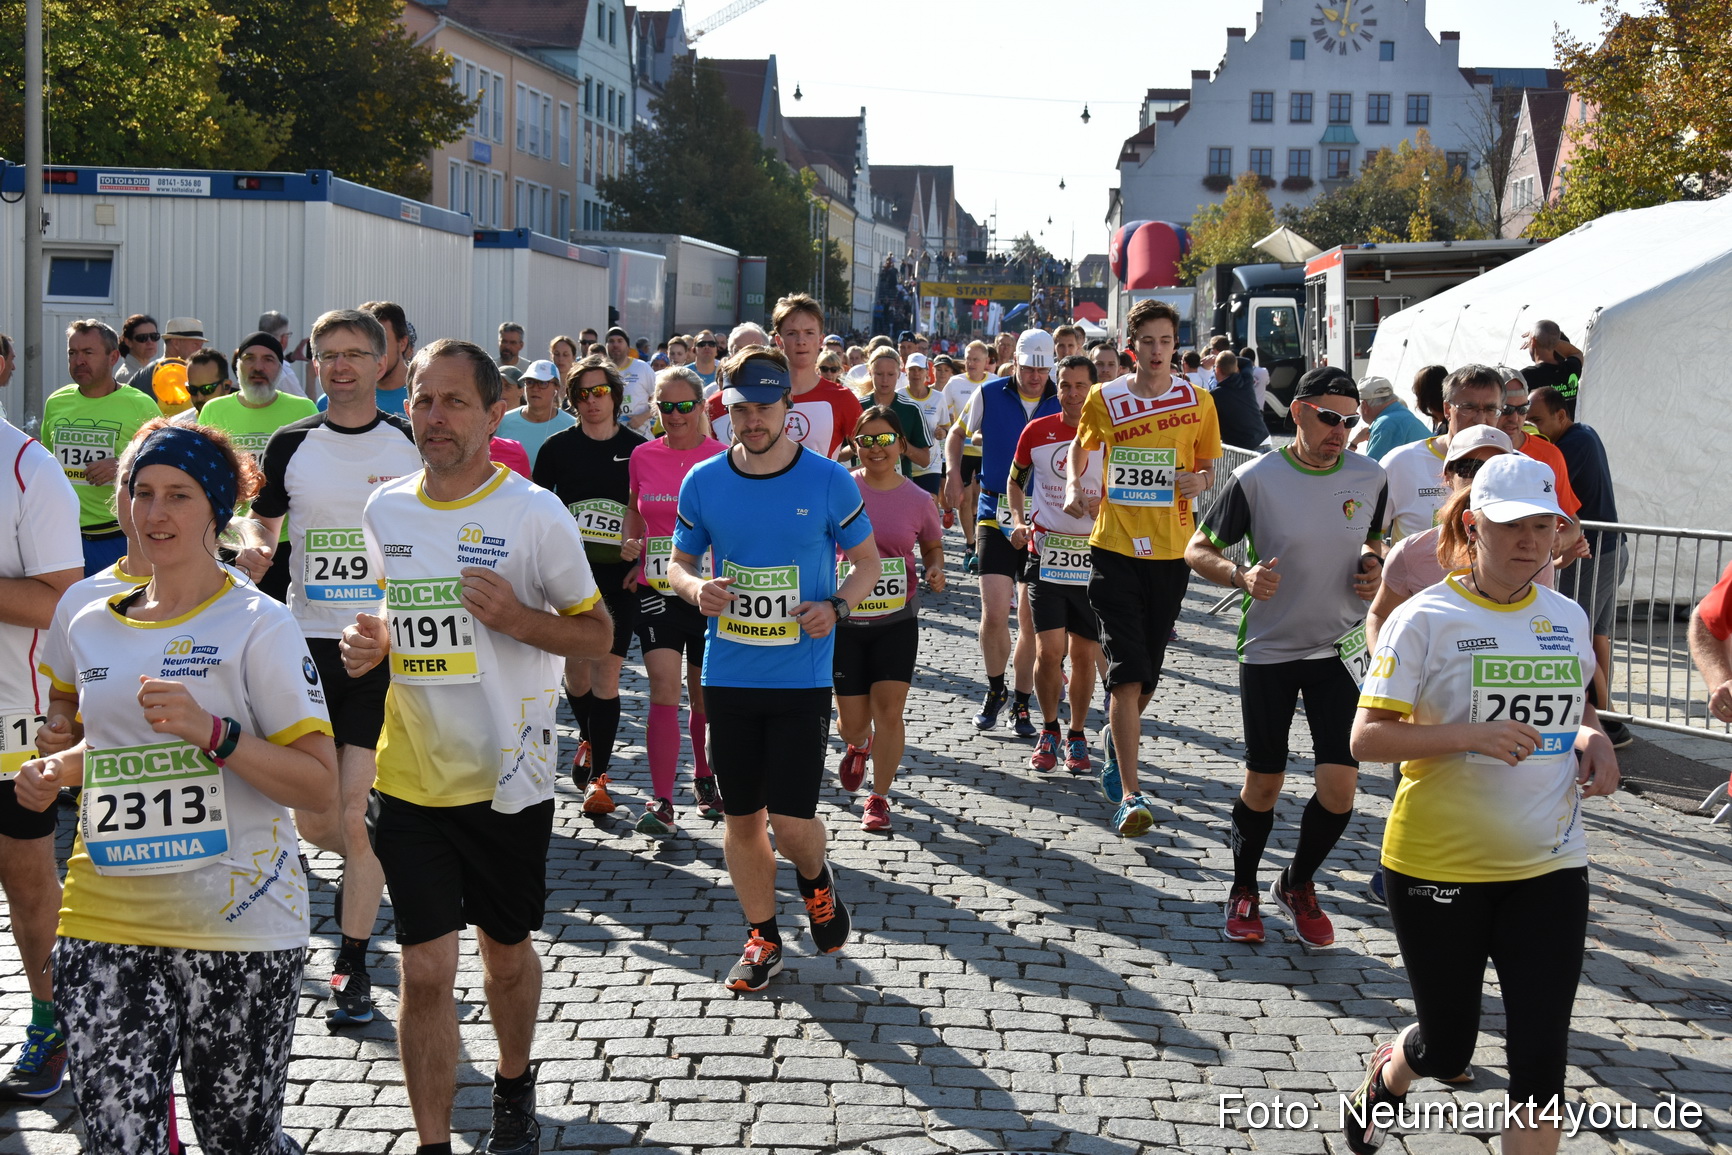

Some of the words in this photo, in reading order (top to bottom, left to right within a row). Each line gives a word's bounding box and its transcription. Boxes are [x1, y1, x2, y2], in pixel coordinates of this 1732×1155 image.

[133, 178, 149, 186] DIXI
[955, 286, 994, 296] START
[1156, 412, 1201, 431] BÖGL
[59, 431, 108, 445] BOCK
[1113, 423, 1153, 443] MAX
[232, 436, 269, 448] BOC
[1114, 450, 1169, 464] BOCK
[1114, 467, 1167, 487] 2384
[1122, 490, 1157, 500] LUKAS
[311, 532, 366, 548] BOC
[460, 527, 483, 544] 20
[384, 544, 413, 554] BOCK
[458, 544, 509, 558] Neumarkter
[651, 540, 673, 553] BO
[456, 555, 498, 569] Stadtlauf
[1047, 550, 1092, 568] 2308
[314, 555, 369, 581] 249
[658, 581, 671, 589] MA
[869, 579, 900, 597] 66
[324, 588, 377, 599] DANIEL
[387, 583, 457, 604] BOCK
[729, 591, 787, 619] 1301
[857, 602, 889, 610] AIGUL
[392, 615, 458, 648] 1191
[726, 621, 787, 637] ANDREAS
[1532, 619, 1552, 634] 20
[1457, 637, 1497, 649] BOCK
[1535, 635, 1574, 643] Neumarkter
[166, 640, 192, 655] 20
[194, 646, 217, 654] JAHRE
[1539, 643, 1572, 653] Stadtlauf
[162, 657, 222, 666] Neumarkter
[402, 659, 448, 672] PETER
[1371, 655, 1396, 679] 20
[160, 667, 209, 679] Stadtlauf
[1483, 660, 1575, 683] BOCK
[1485, 693, 1573, 727] 2657
[93, 746, 203, 781] BOCK
[210, 786, 217, 794] D
[97, 785, 207, 833] 2313
[105, 838, 206, 862] MARTINA
[275, 849, 289, 871] 2019
[1408, 887, 1432, 896] great
[1439, 887, 1461, 896] run
